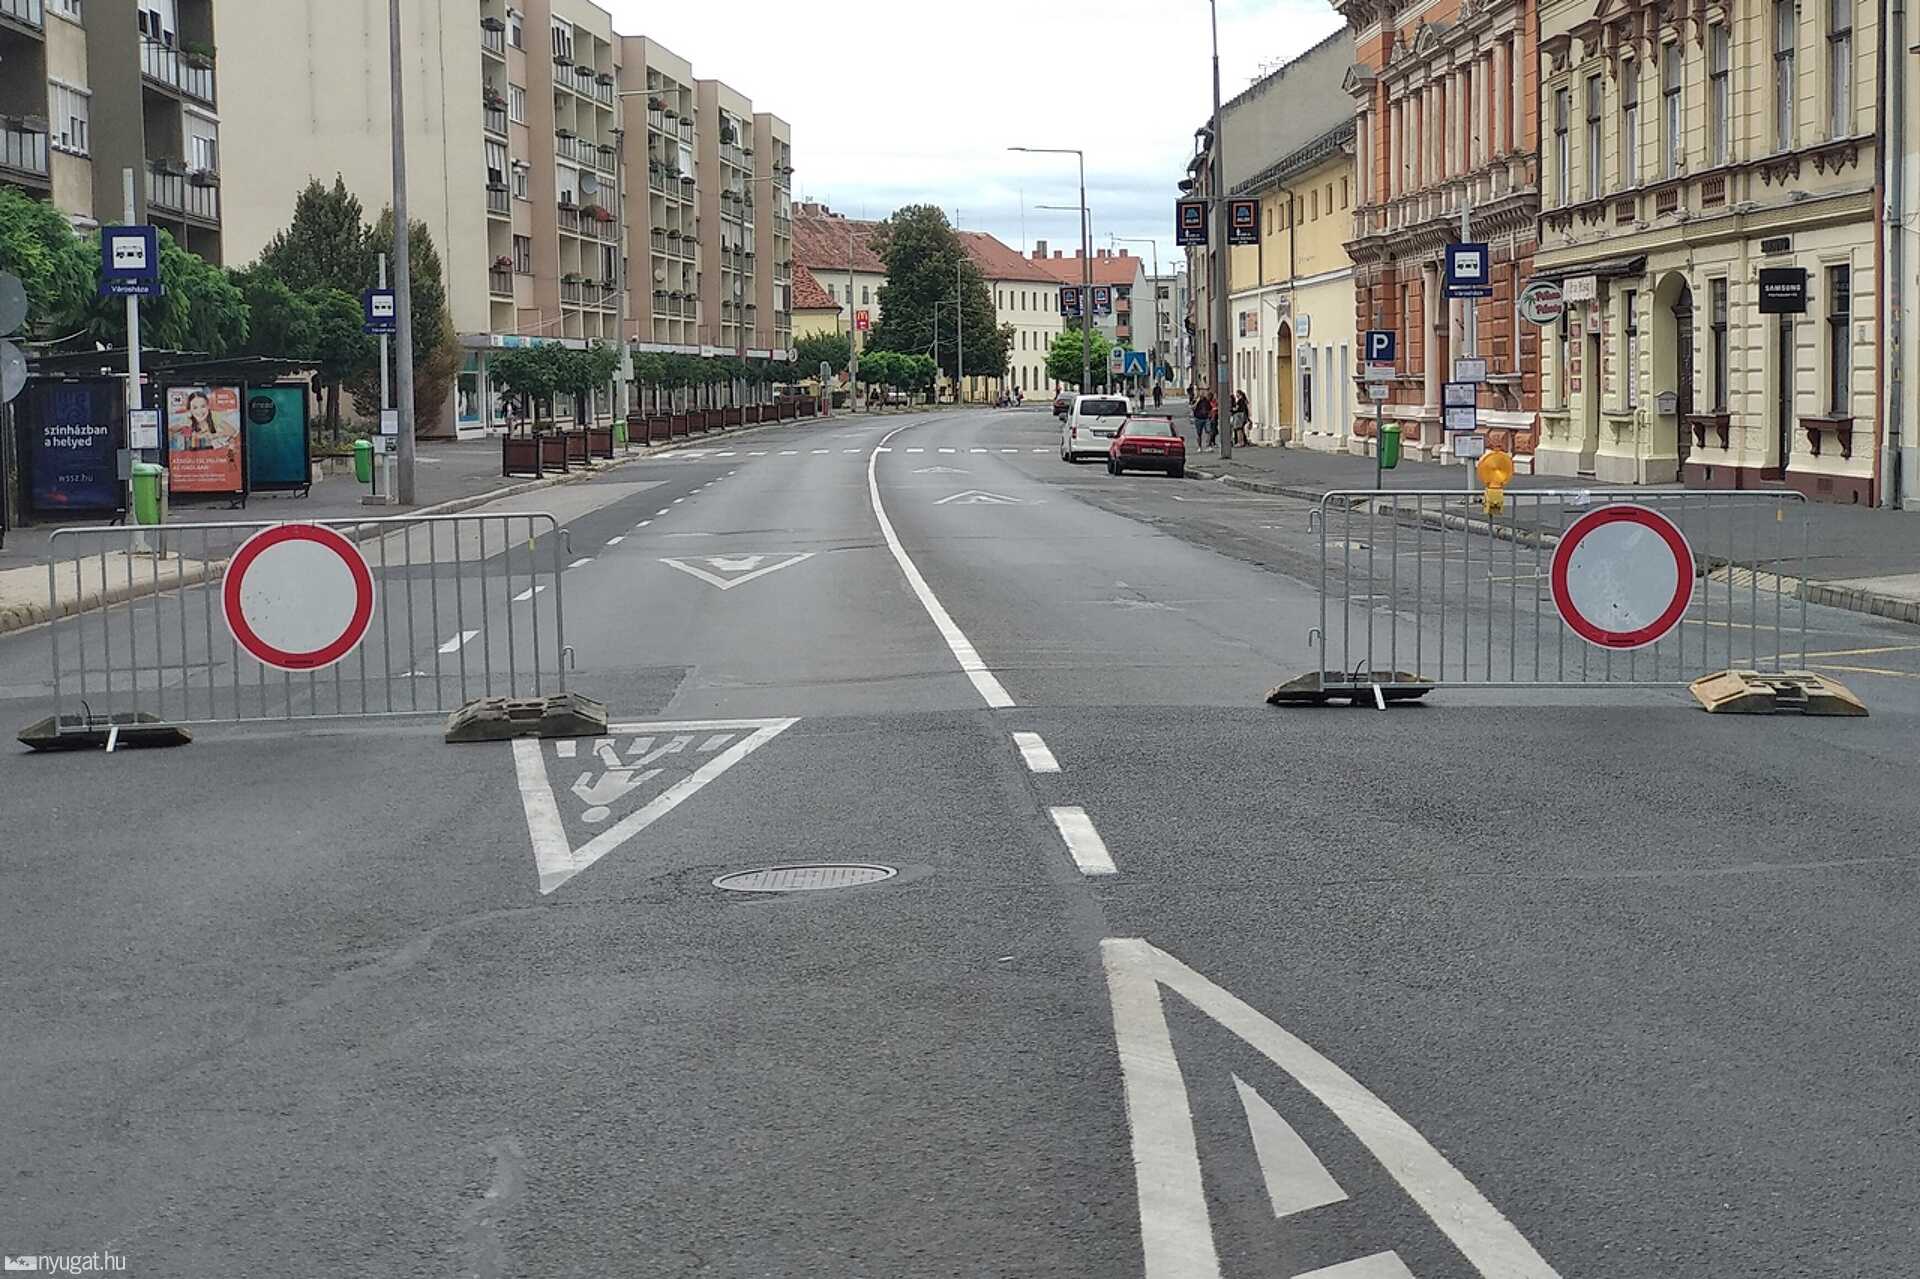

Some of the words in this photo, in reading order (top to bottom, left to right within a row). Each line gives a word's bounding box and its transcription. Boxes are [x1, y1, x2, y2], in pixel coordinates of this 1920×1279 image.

[1764, 284, 1801, 292] SAMSUNG
[1372, 333, 1389, 358] P
[44, 424, 108, 436] színházban
[44, 438, 52, 447] a
[53, 436, 93, 449] helyed
